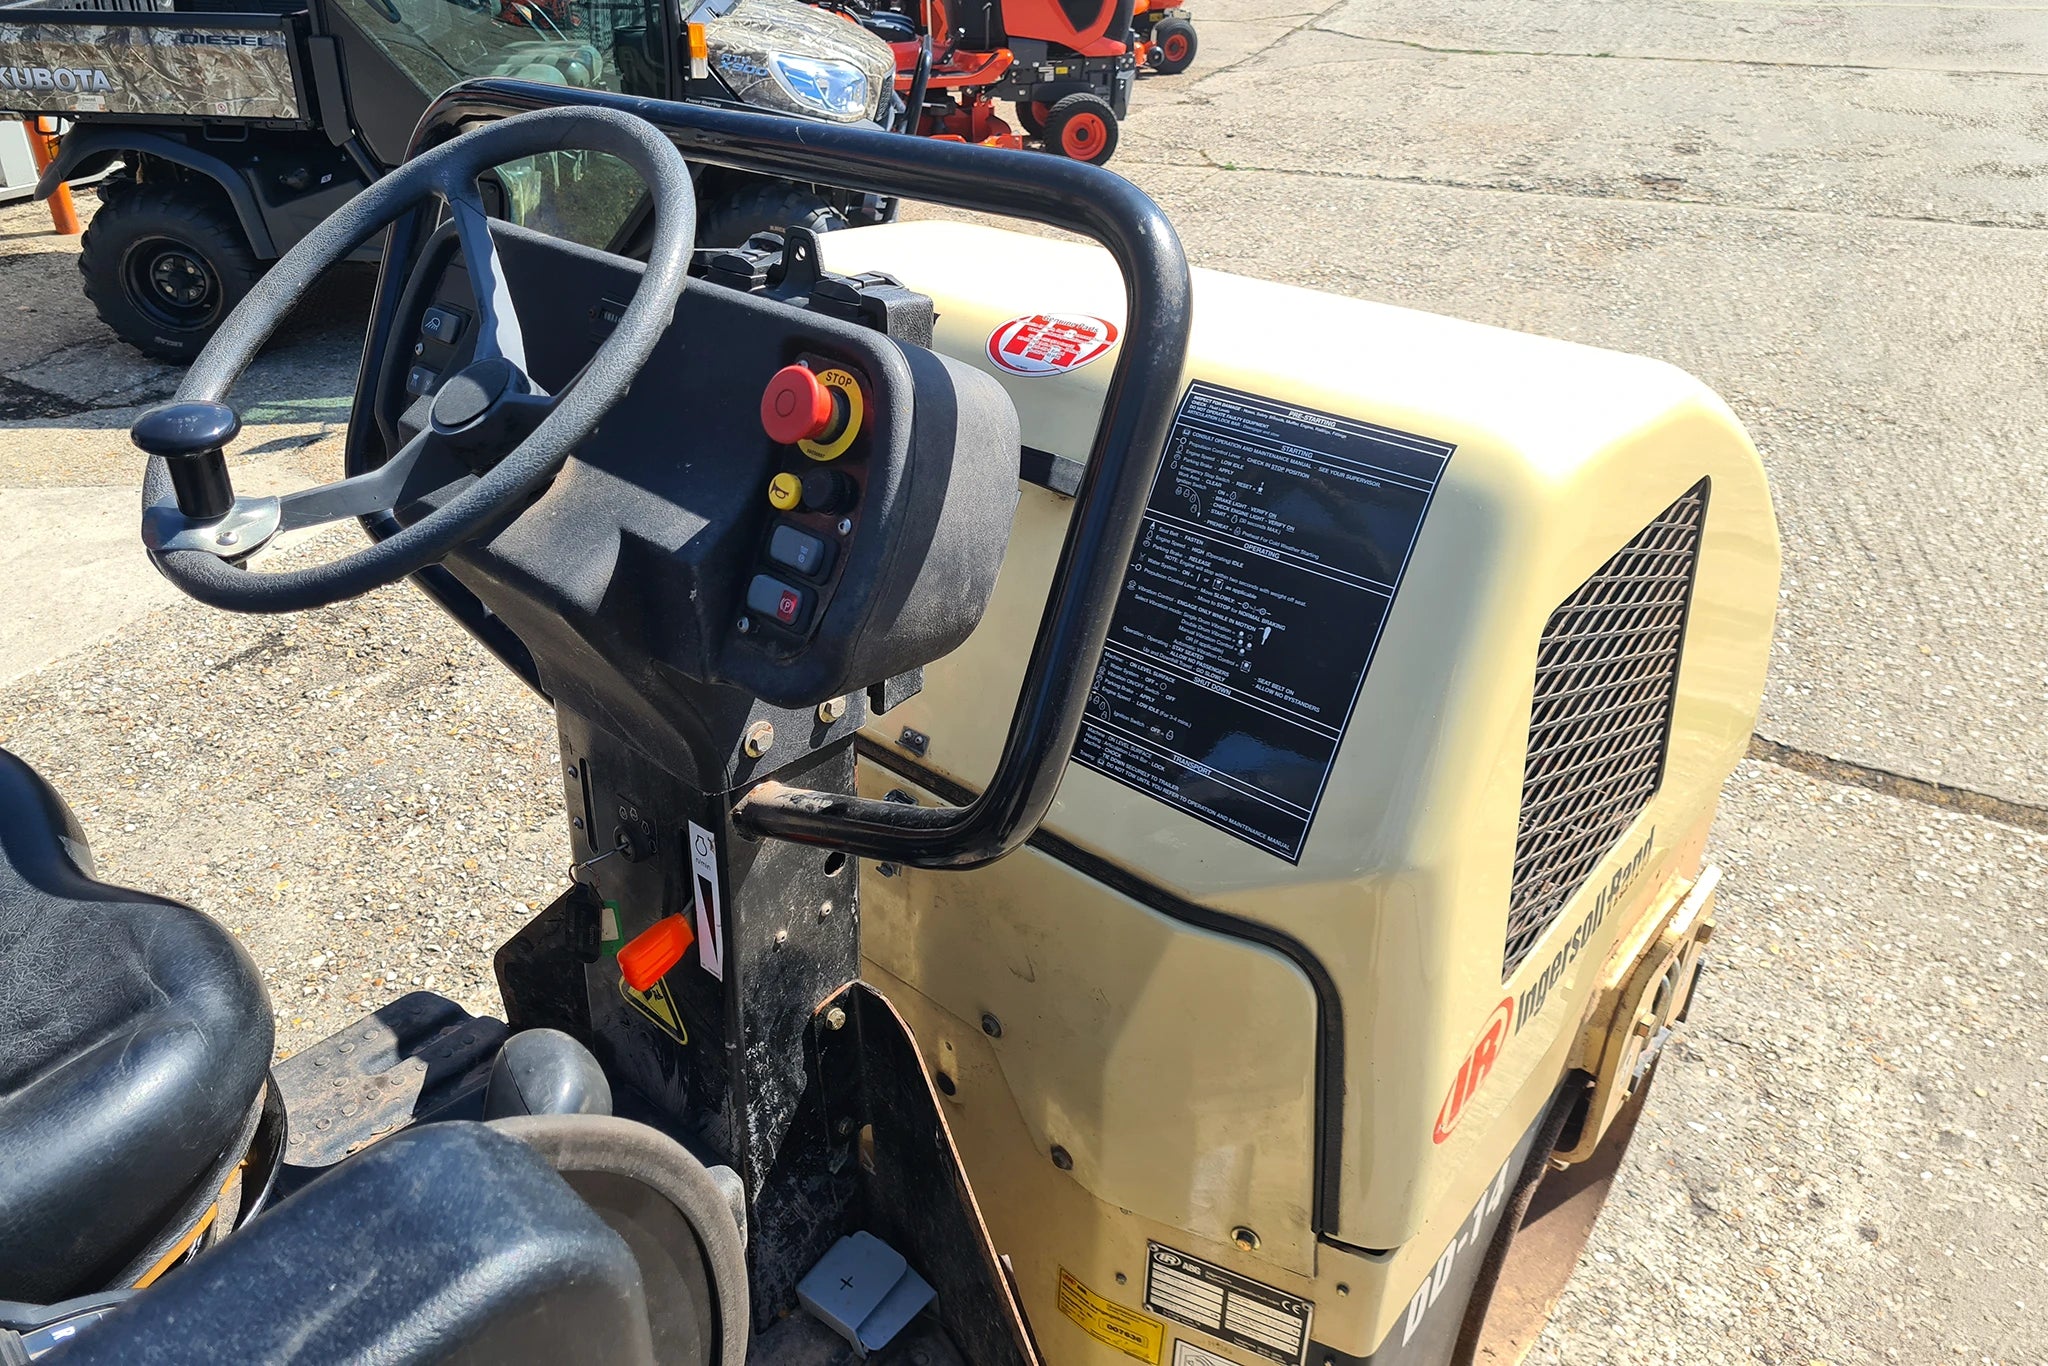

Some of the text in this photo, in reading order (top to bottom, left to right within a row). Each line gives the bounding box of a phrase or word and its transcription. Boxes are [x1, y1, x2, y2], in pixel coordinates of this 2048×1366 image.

[179, 32, 273, 47] DIESEL
[720, 60, 768, 77] X900
[1043, 314, 1077, 327] Genuine
[826, 371, 852, 387] STOP
[1190, 399, 1207, 407] CHECK
[1192, 395, 1212, 403] INSPECT
[1221, 402, 1241, 411] DAMAGE
[1205, 408, 1226, 418] OPERATE
[1225, 413, 1243, 422] FAULTY
[1242, 418, 1269, 429] EQUIPMENT
[1287, 410, 1337, 428] PRE-STARTING
[1185, 449, 1244, 470] Engine Speed LOW IDLE
[1187, 441, 1211, 452] Propulsion
[1211, 447, 1228, 456] Control
[1227, 451, 1241, 459] Lever
[1246, 457, 1264, 466] CHECK
[1270, 463, 1285, 472] STOP
[1284, 467, 1310, 479] POSITION
[1191, 431, 1214, 442] CONSULT
[1213, 437, 1242, 449] OPERATION
[1253, 448, 1290, 462] MAINTENANCE
[1289, 458, 1312, 468] MANUAL
[1317, 465, 1330, 473] SEE
[1329, 469, 1345, 478] YOUR
[1280, 444, 1314, 459] STARTING
[1182, 456, 1234, 475] Parking Brake APPLY
[1179, 465, 1252, 490] Emergency RESET
[1205, 478, 1222, 488] CLEAR
[1209, 508, 1226, 517] START
[1212, 502, 1295, 532] CHECK ENGINE LIGHT VERIFY ON
[1214, 495, 1278, 520] BRAKE LIGHT VERIFY ON
[1206, 519, 1229, 531] PREHEAT
[1183, 535, 1204, 545] FASTEN
[1151, 543, 1211, 567] Parking Brake RELEASE
[1154, 534, 1244, 568] Engine Speed HIGH IDLE
[1242, 542, 1280, 559] OPERATING
[1143, 567, 1197, 590] Propulsion Control Lever
[1137, 584, 1157, 596] Vibration
[1157, 591, 1174, 602] Control
[1176, 598, 1198, 610] ENGAGE
[1197, 606, 1212, 615] ONLY
[1211, 611, 1228, 621] WHILE
[1234, 619, 1257, 631] MOTION
[1215, 601, 1286, 631] STOP NORMAL BRAKING
[1197, 616, 1232, 633] Drum Vibration
[1197, 624, 1232, 641] Drum Vibration
[1195, 631, 1234, 650] Vibration Control
[1171, 644, 1204, 660] STAY SEATED
[1196, 647, 1235, 666] Vibration Control
[1169, 650, 1187, 661] ALLOW
[1195, 660, 1230, 677] PASSENGERS
[1137, 664, 1152, 674] LEVEL
[1152, 670, 1176, 684] SURFACE
[1144, 676, 1155, 684] OFF
[1195, 666, 1225, 682] GO SLOWLY
[1103, 678, 1155, 703] Parking Brake APPLY
[1193, 676, 1231, 696] SHUT DOWN
[1256, 677, 1295, 696] SEAT BELT ON
[1101, 686, 1159, 714] Engine Speed LOW IDLE
[1165, 694, 1176, 702] OFF
[1254, 683, 1320, 713] ALLOW NO BYSTANDERS
[1149, 726, 1161, 734] OFF
[1103, 747, 1122, 759] CHOCK
[1115, 738, 1130, 749] LEVEL
[1129, 745, 1152, 759] SURFACE
[1101, 752, 1179, 792] TIE DOWN SECURELY TO TRAILER
[1150, 761, 1165, 772] LOCK
[1172, 754, 1212, 776] TRANSPORT
[1105, 761, 1291, 851] DO NOT TOW UNTIL YOU REFER TO OPERATION AND MAINTENANCE MANUAL
[1514, 824, 1657, 1036] Ingersoll Rand
[1402, 1159, 1512, 1348] DD-14
[1182, 1262, 1202, 1276] ABG
